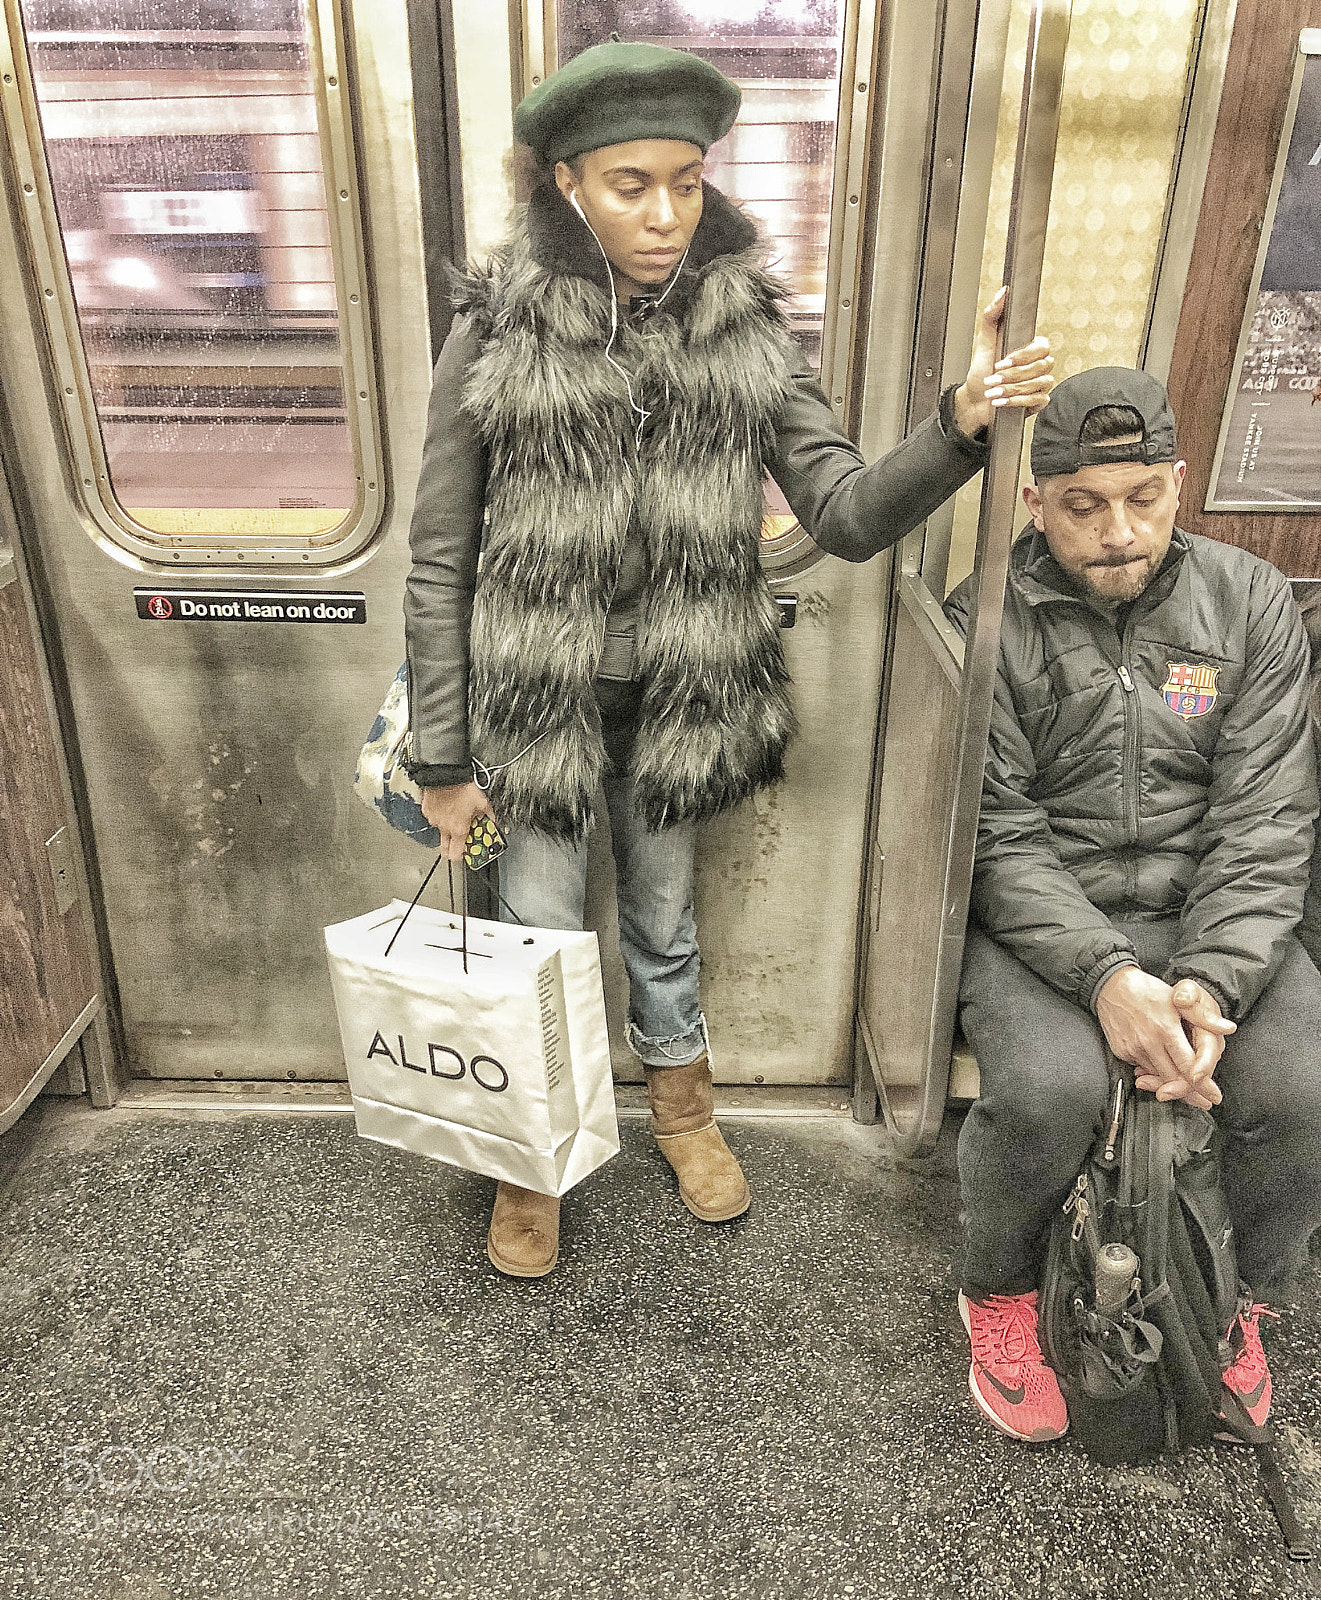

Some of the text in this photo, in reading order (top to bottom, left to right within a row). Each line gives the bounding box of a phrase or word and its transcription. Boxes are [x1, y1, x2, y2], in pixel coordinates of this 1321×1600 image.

[1237, 412, 1258, 483] YANKEE STADIUM
[1249, 425, 1263, 471] JOIN US AT
[180, 600, 357, 619] Do not lean on door
[366, 1030, 509, 1093] ALDO
